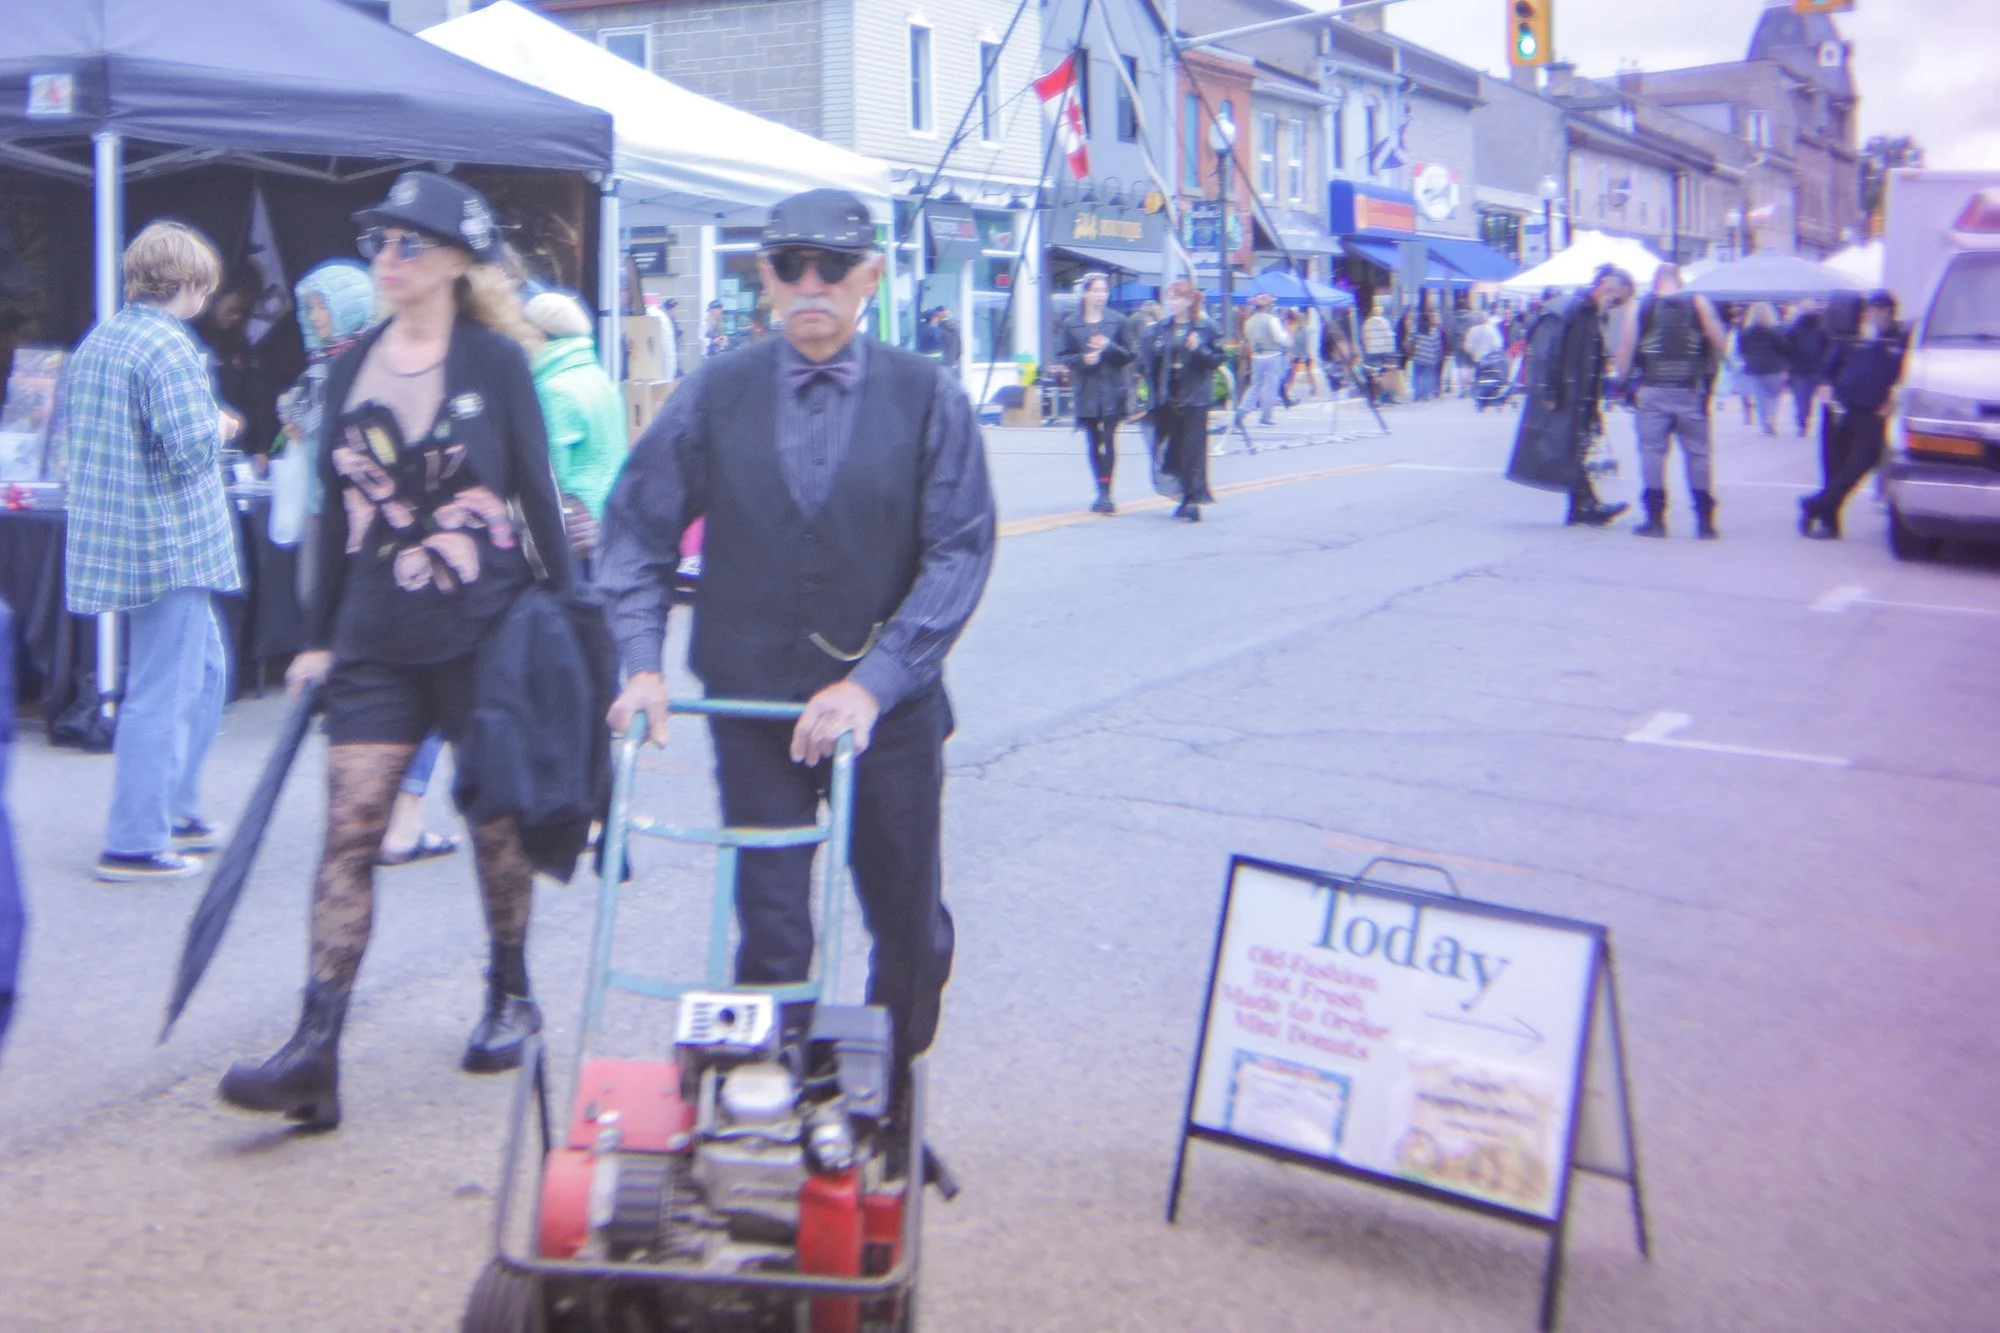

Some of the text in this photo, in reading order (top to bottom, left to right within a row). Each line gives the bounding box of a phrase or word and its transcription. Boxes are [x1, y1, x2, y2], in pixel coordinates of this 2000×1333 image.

[1310, 884, 1512, 1010] Today
[1300, 980, 1363, 1012] Fresh
[1320, 1010, 1391, 1041] Order
